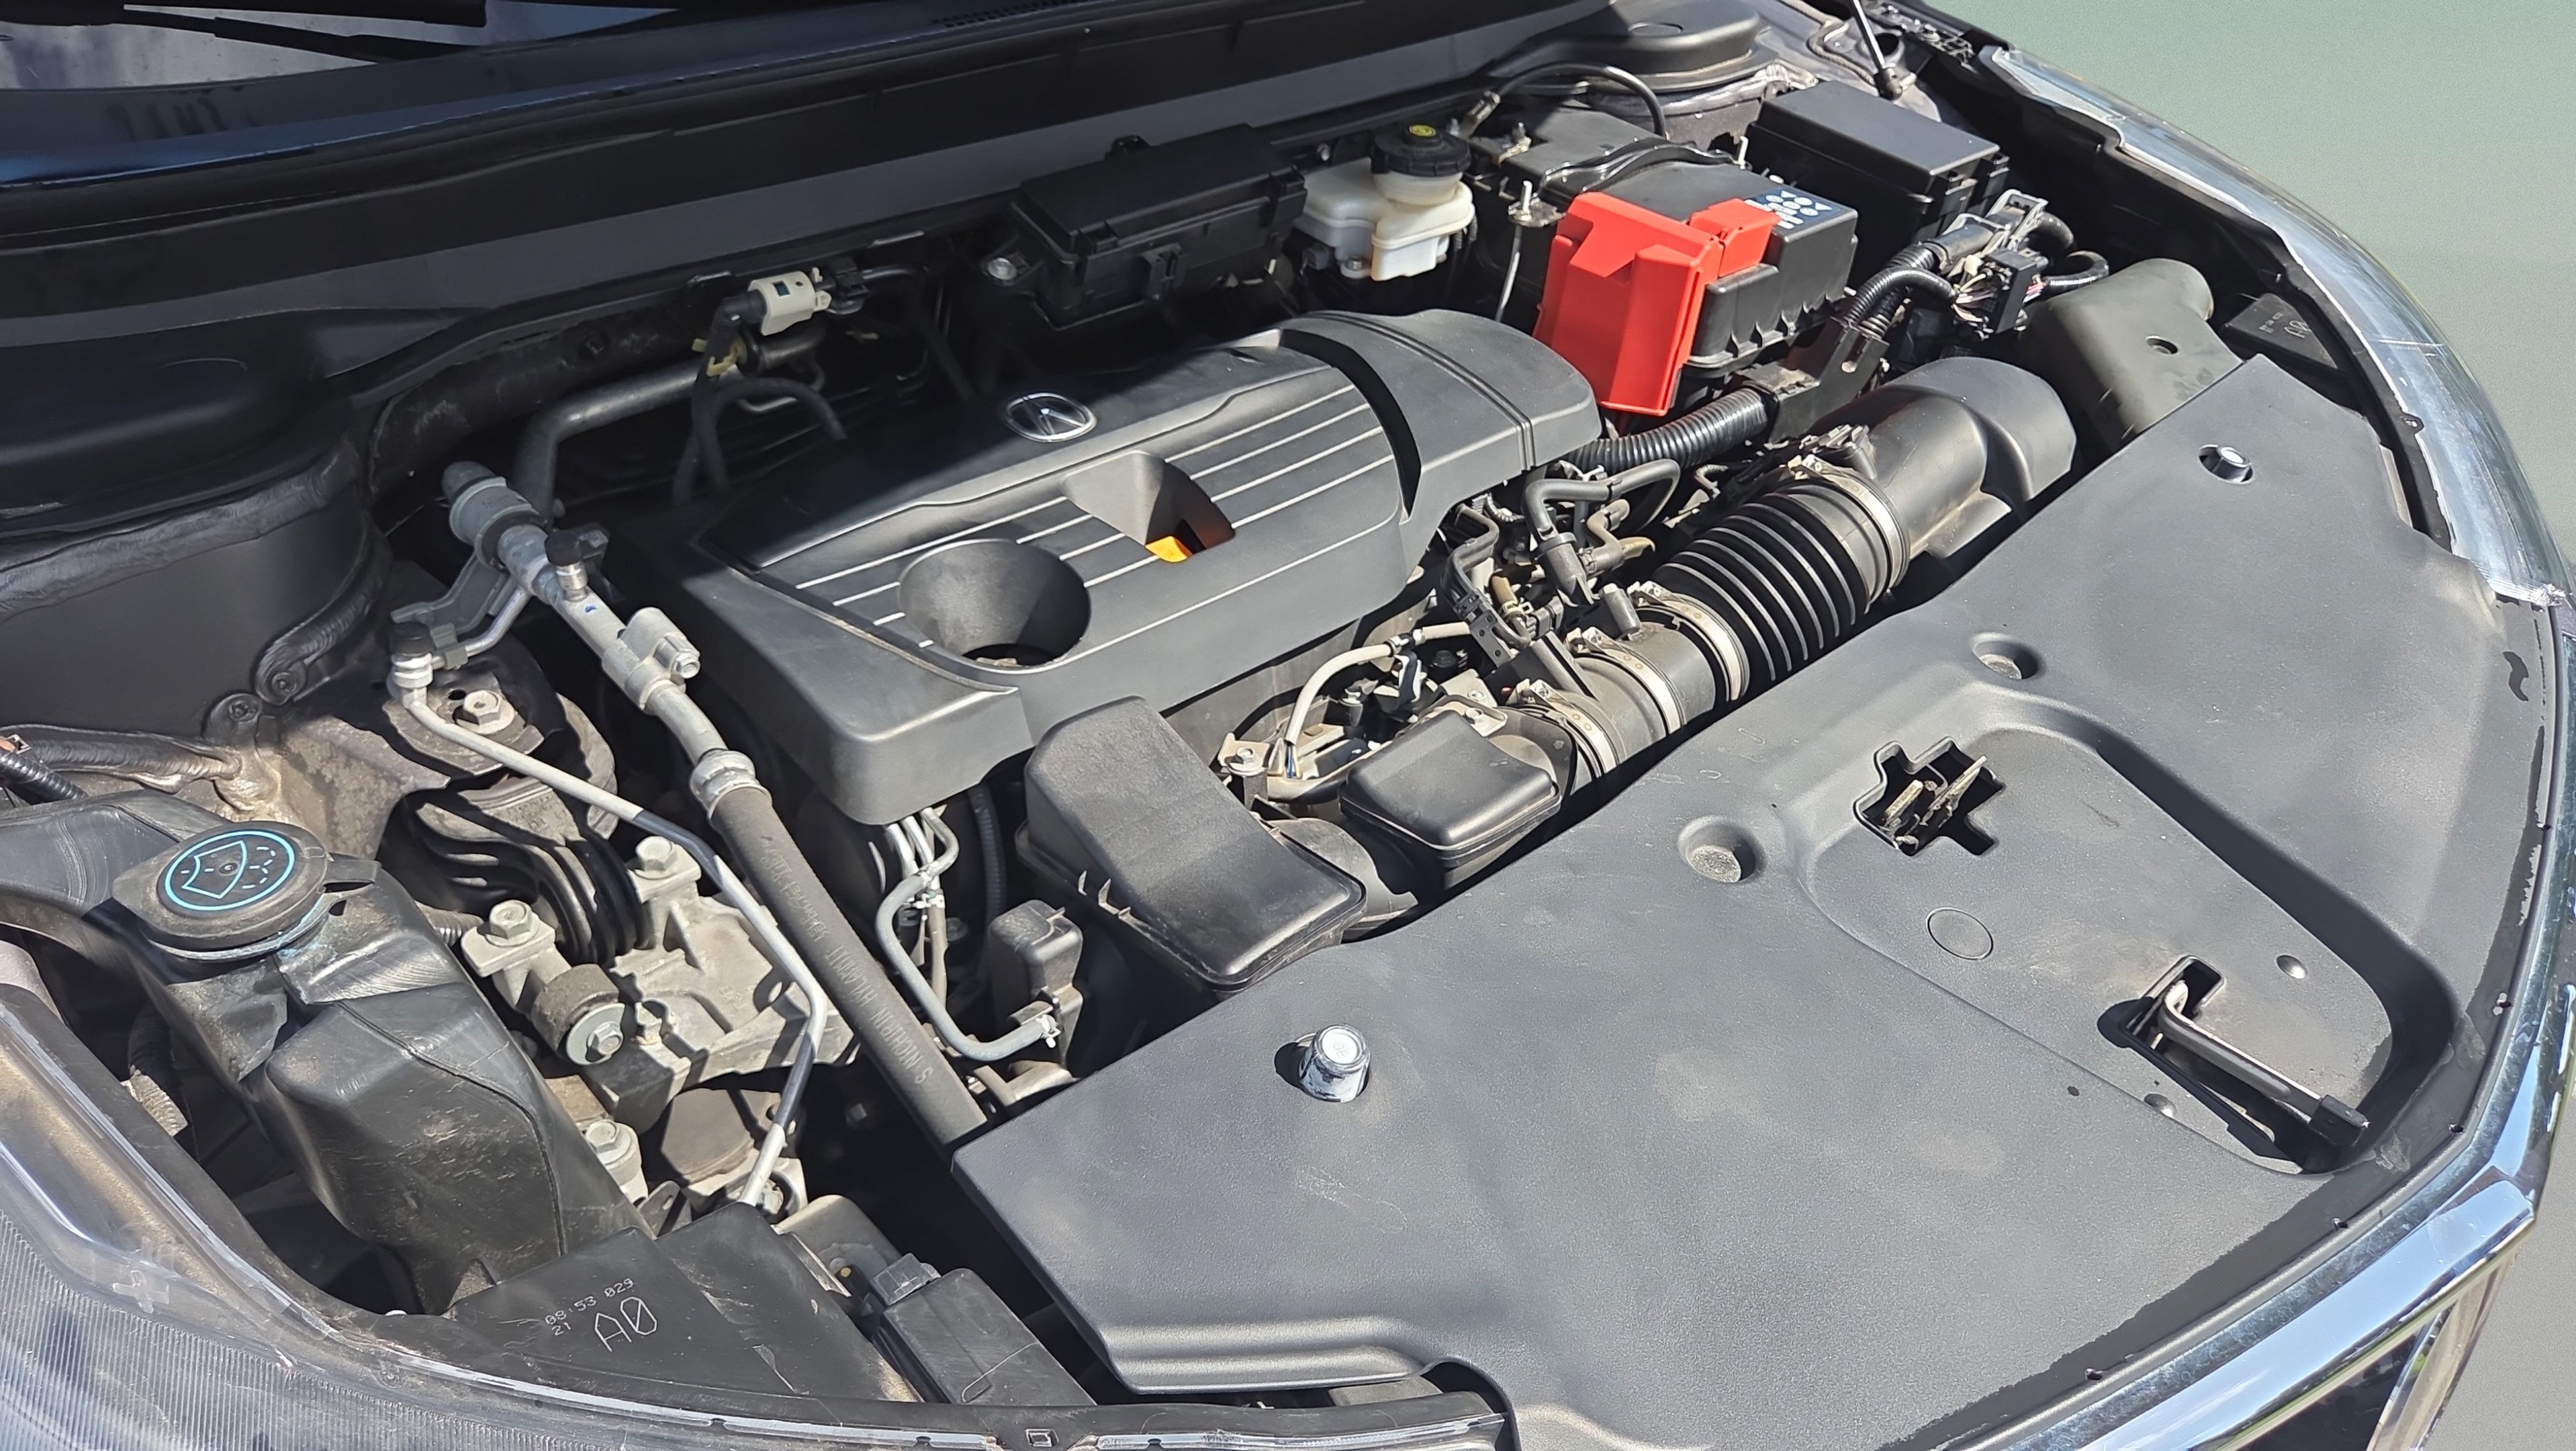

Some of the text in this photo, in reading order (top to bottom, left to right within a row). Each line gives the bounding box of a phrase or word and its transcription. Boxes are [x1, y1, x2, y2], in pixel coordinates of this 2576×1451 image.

[604, 1278, 634, 1297] 029
[551, 1321, 571, 1336] 21
[594, 1296, 657, 1352] A0
